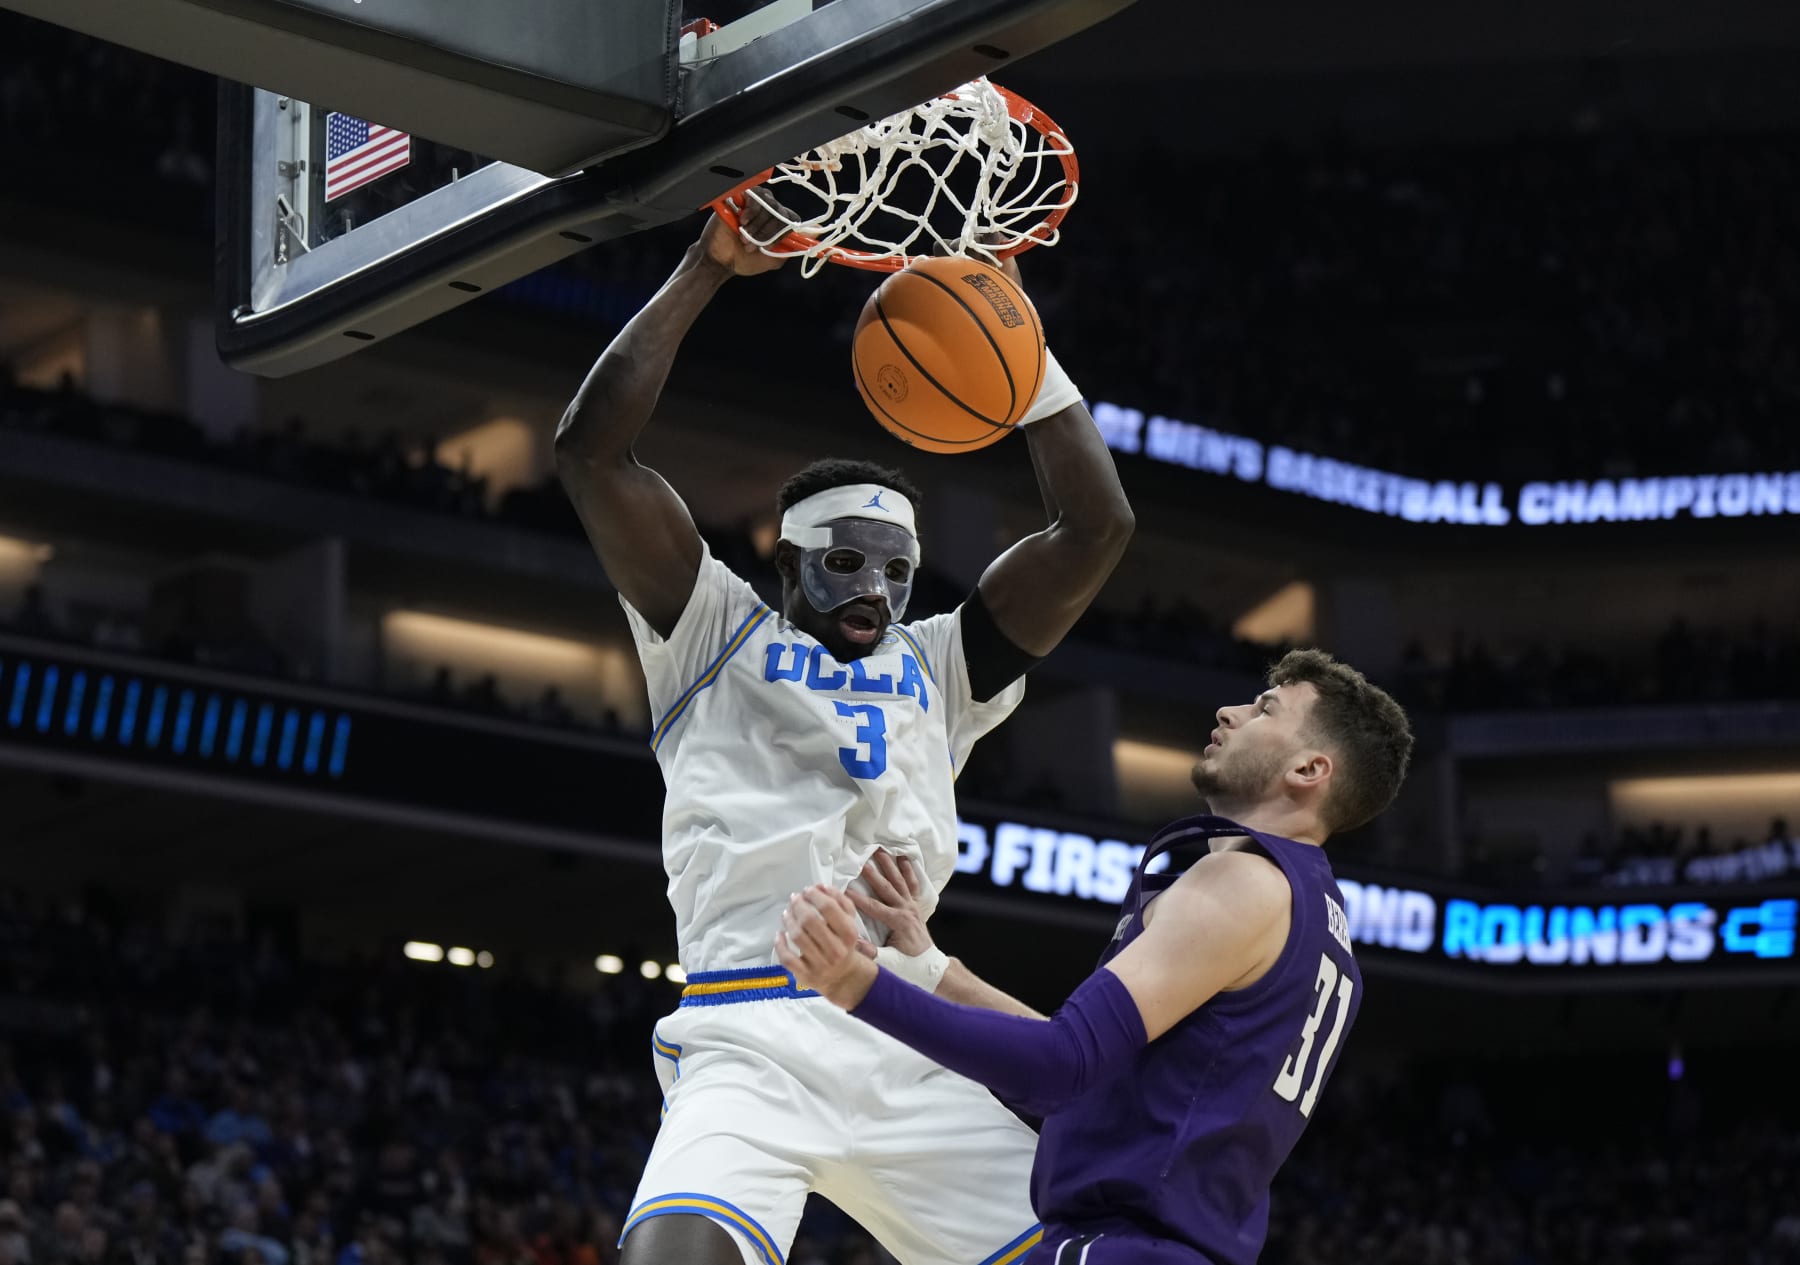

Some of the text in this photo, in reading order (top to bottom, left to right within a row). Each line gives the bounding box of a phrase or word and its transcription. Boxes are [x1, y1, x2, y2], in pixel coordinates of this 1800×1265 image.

[1265, 445, 1511, 526] BASKETBALL
[764, 642, 929, 714] UCLA
[831, 700, 887, 780] 3
[1443, 898, 1716, 966] ROUNDS
[1272, 952, 1354, 1118] 31
